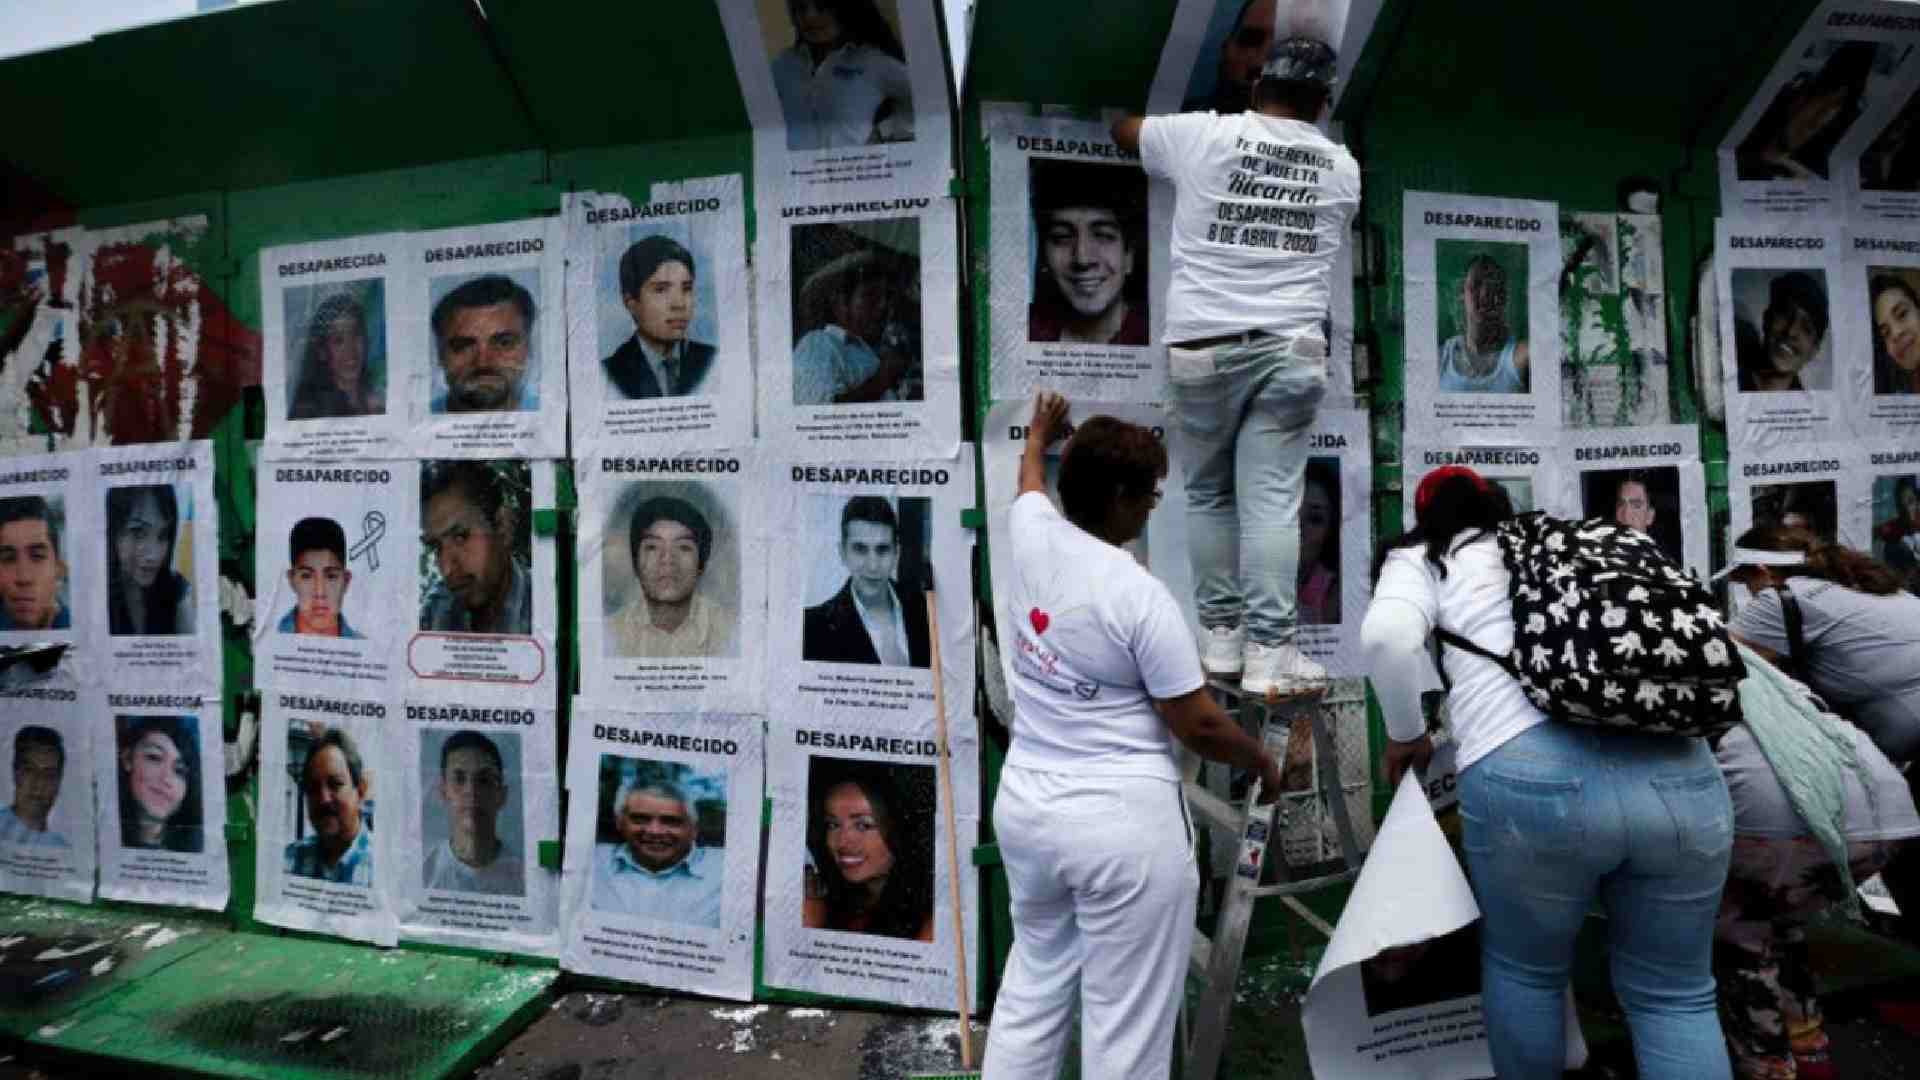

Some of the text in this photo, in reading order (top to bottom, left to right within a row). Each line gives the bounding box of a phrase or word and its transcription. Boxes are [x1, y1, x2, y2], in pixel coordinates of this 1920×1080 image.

[1236, 136, 1335, 171] TE QUEREMOS
[1241, 156, 1319, 184] DE VUELTA
[586, 197, 720, 225] DESAPARECIDO
[1218, 202, 1317, 231] DESAPARECIDO
[1423, 210, 1541, 233] DESAPARECIDO
[1206, 222, 1318, 253] 8 DE ABRIL 2020
[1730, 236, 1824, 249] DESAPARECIDO
[425, 238, 545, 264] DESAPARECIDO
[278, 252, 387, 277] DESAPARECIDA
[1424, 451, 1540, 465] DESAPARECIDO
[1576, 442, 1681, 461] DESAPARECIDO
[275, 467, 390, 484] DESAPARECIDO
[601, 457, 740, 473] DESAPARECIDO
[791, 466, 949, 486] DESAPARECIDO
[1743, 460, 1840, 477] DESAPARECIDO
[279, 695, 386, 719] DESAPARECIDO
[406, 705, 535, 725] DESAPARECIDO
[594, 723, 738, 755] DESAPARECIDO
[795, 728, 951, 758] DESAPARECID
